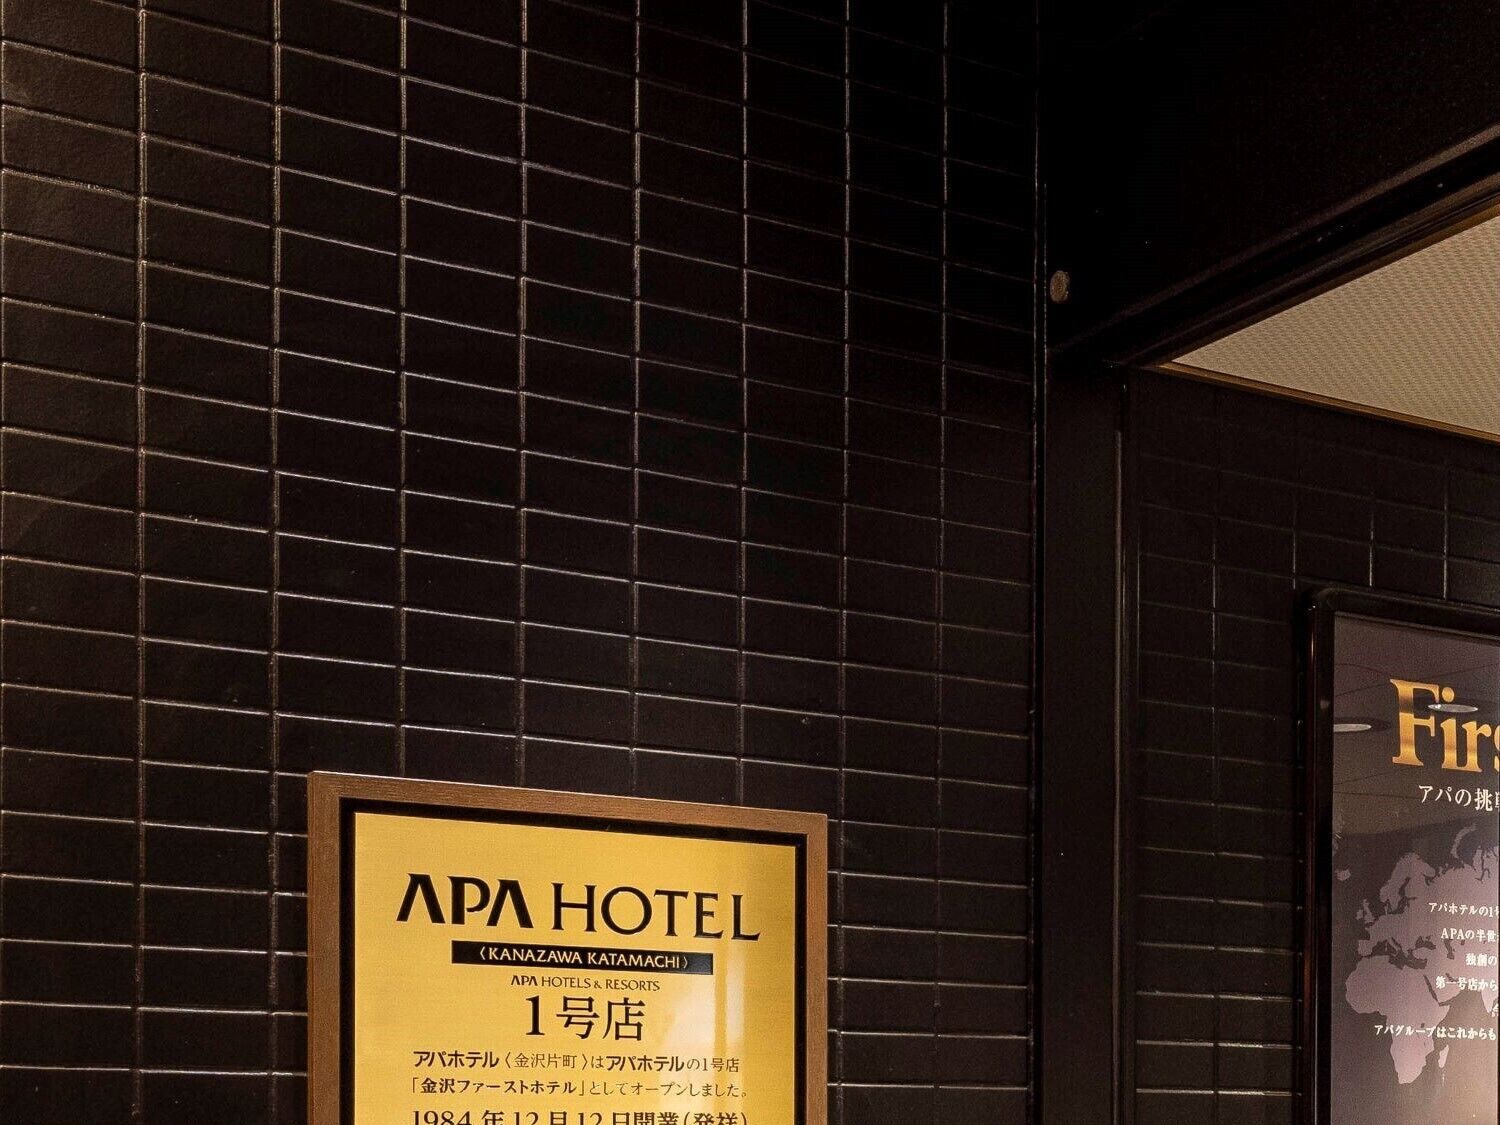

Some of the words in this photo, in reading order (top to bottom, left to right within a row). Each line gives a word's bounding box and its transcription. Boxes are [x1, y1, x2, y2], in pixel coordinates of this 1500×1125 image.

[396, 873, 534, 928] APA
[552, 882, 760, 941] HOTEL
[1440, 928, 1499, 942] APAの半世
[511, 975, 537, 986] APA
[541, 976, 591, 989] HOTELS
[594, 981, 602, 989] &
[605, 978, 660, 991] RESORTS
[525, 995, 646, 1042] 1号店
